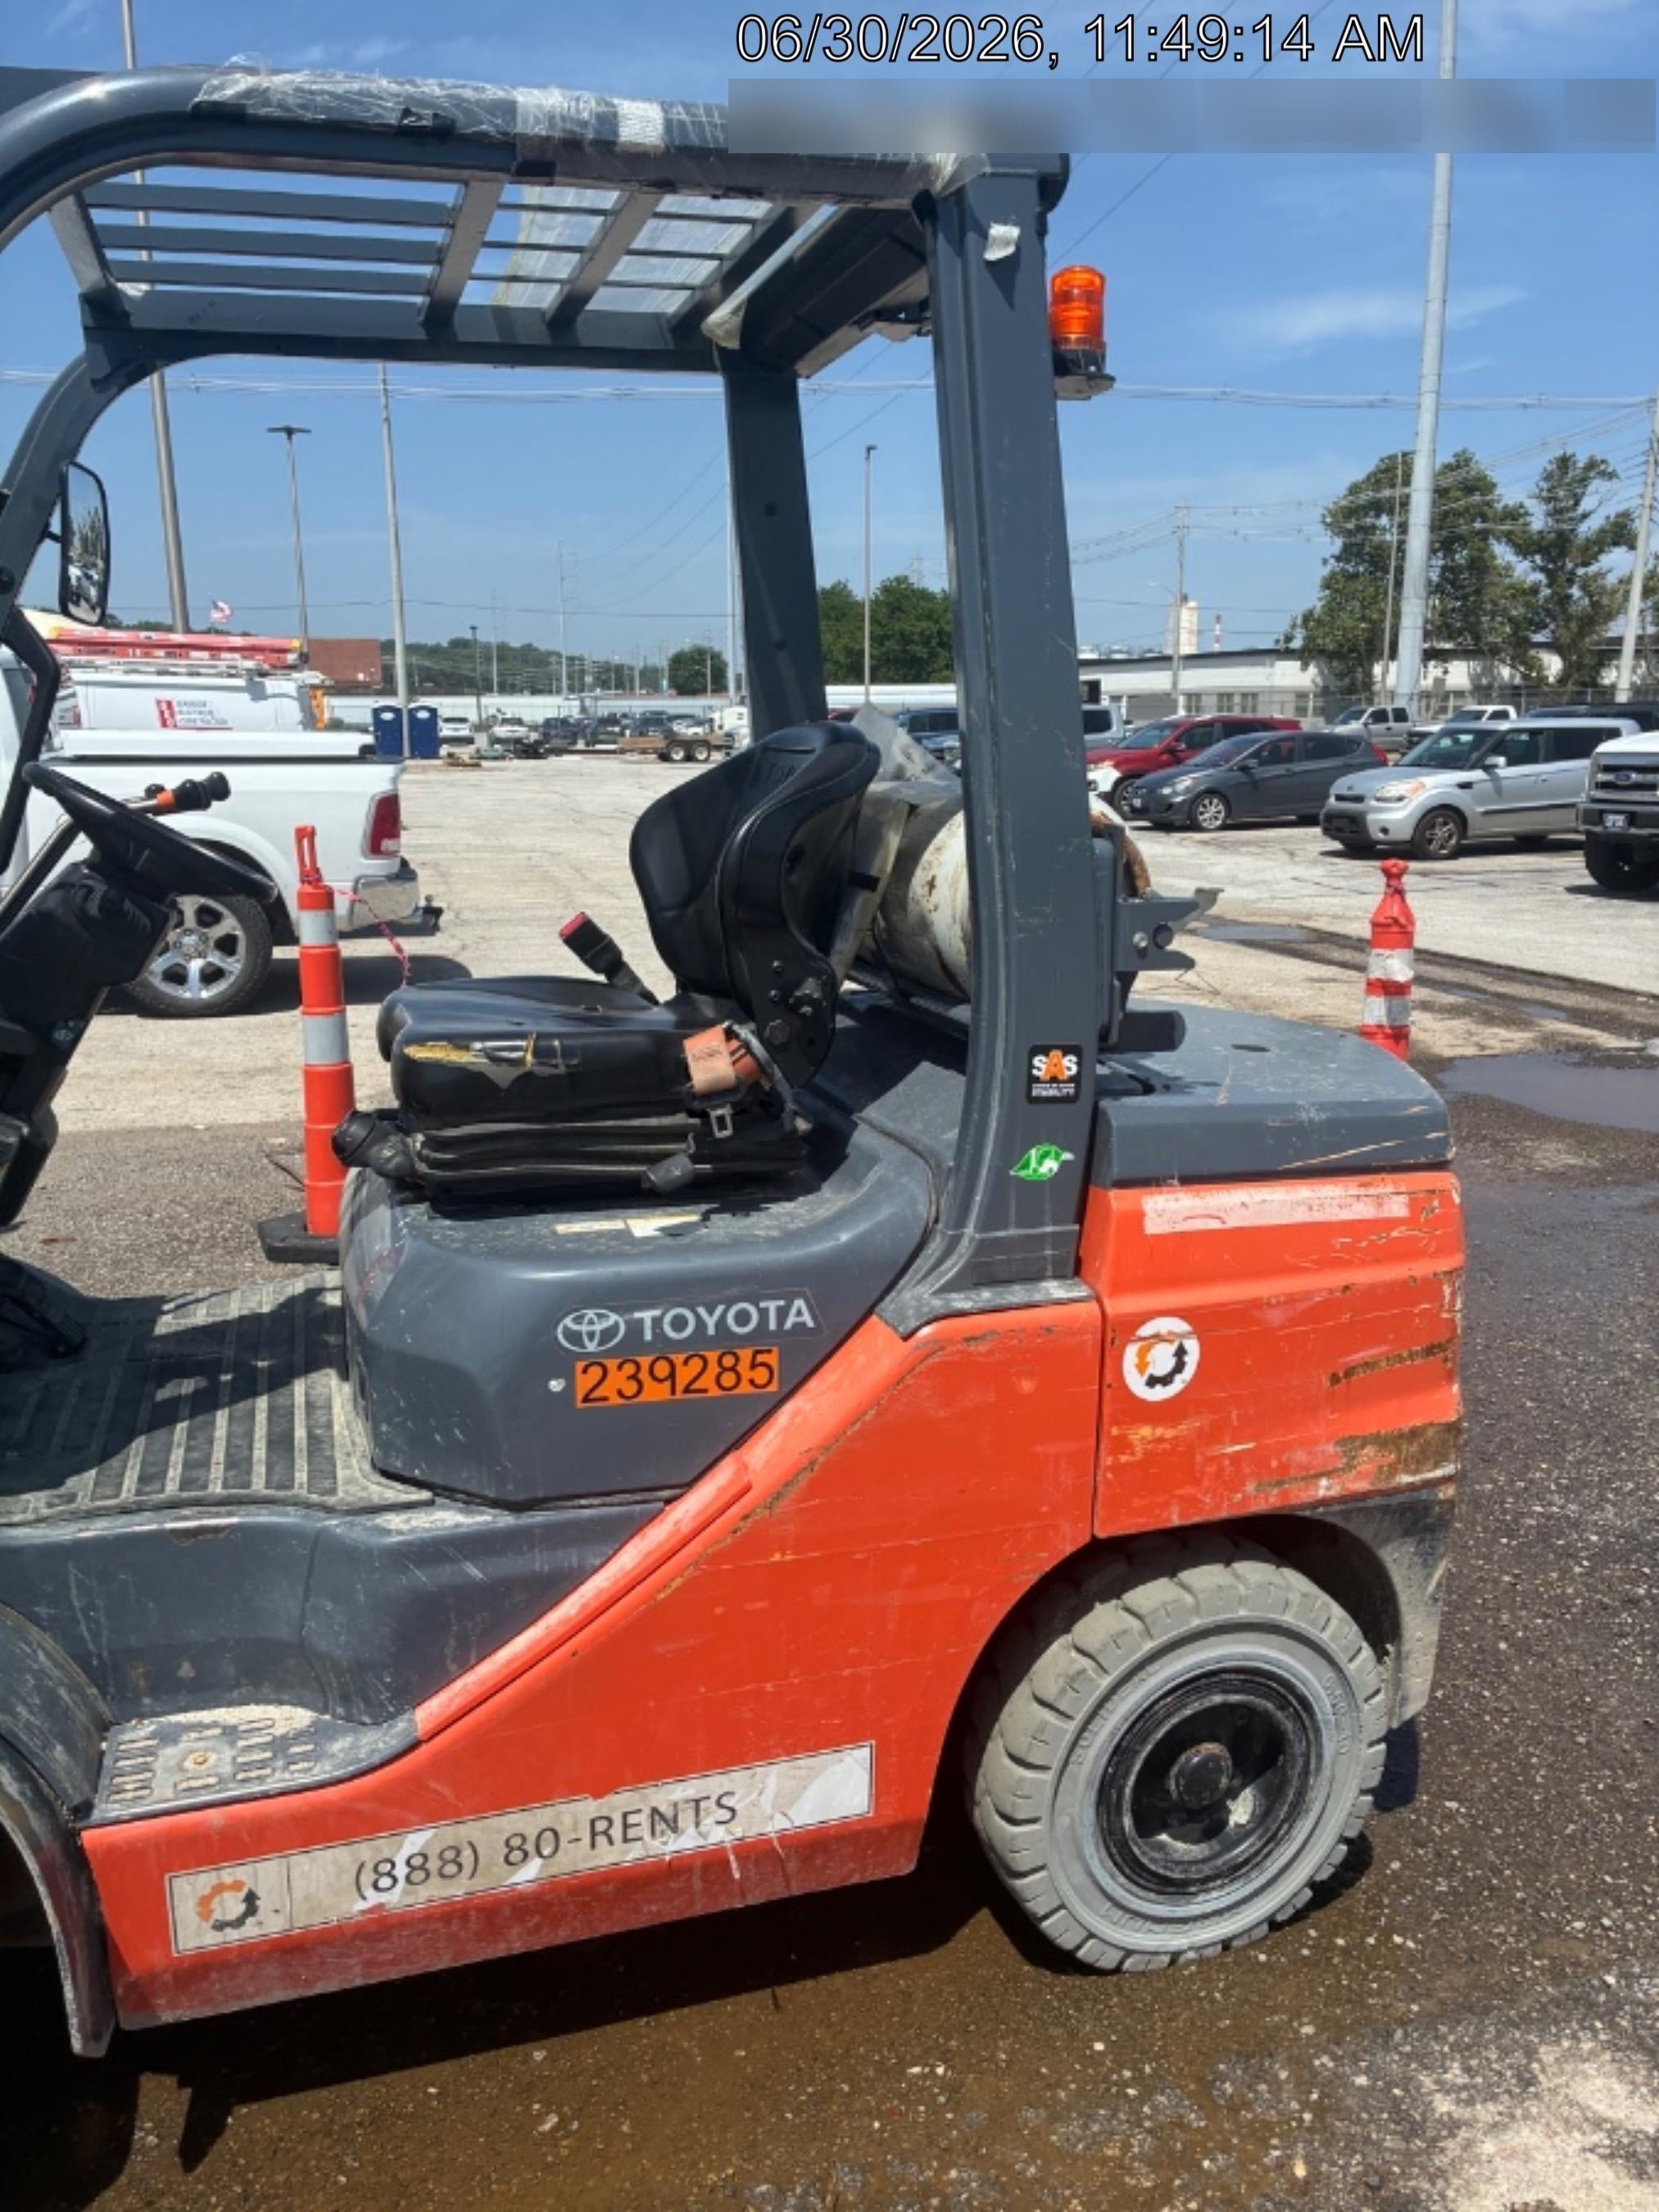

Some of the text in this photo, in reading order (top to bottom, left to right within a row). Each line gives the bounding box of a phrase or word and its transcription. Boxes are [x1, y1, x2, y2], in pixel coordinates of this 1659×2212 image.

[1031, 1049, 1078, 1081] SAS
[632, 1297, 816, 1343] TOYOTA
[579, 1349, 775, 1404] 239285
[353, 1789, 738, 1902] (888) 80-RENTS
